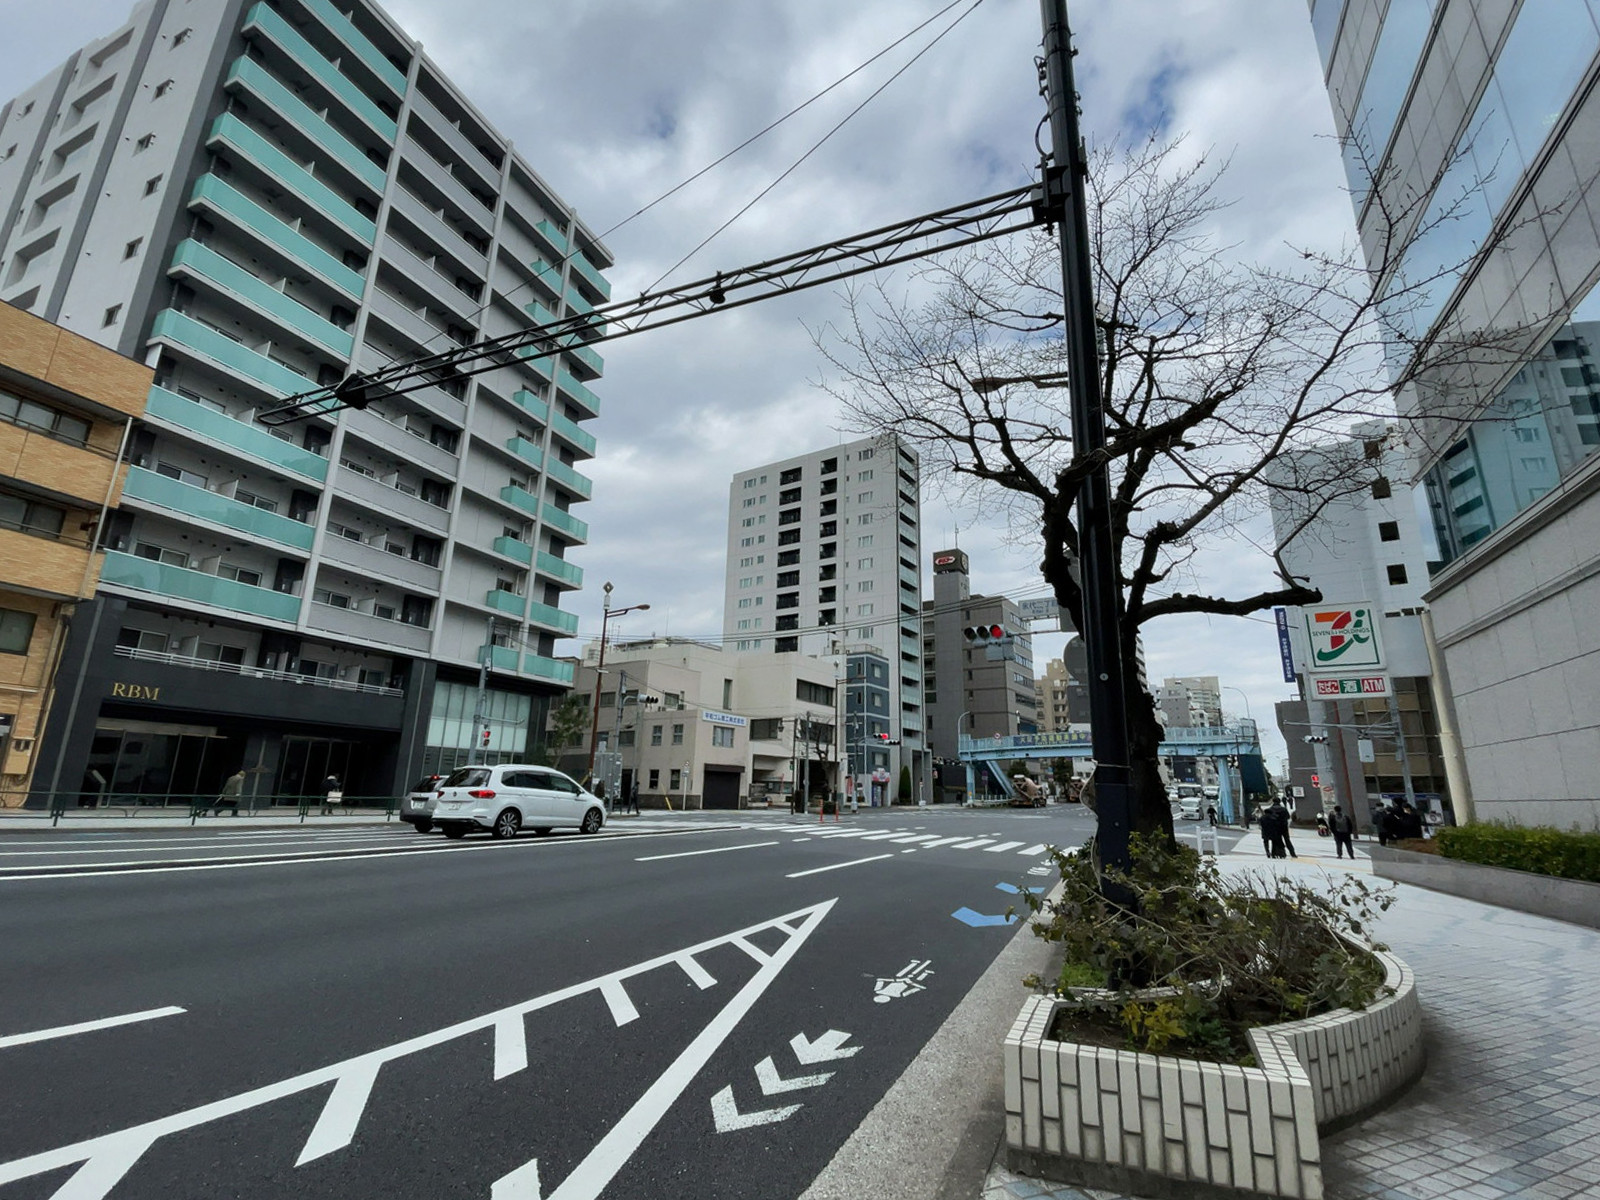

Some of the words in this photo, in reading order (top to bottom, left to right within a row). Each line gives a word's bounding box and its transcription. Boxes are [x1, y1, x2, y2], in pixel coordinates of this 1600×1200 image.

[1339, 627, 1370, 635] HOLDINGS
[112, 682, 160, 701] RBM
[1317, 681, 1339, 694] たばこ
[1343, 680, 1358, 693] 酒
[1364, 679, 1385, 692] ATM
